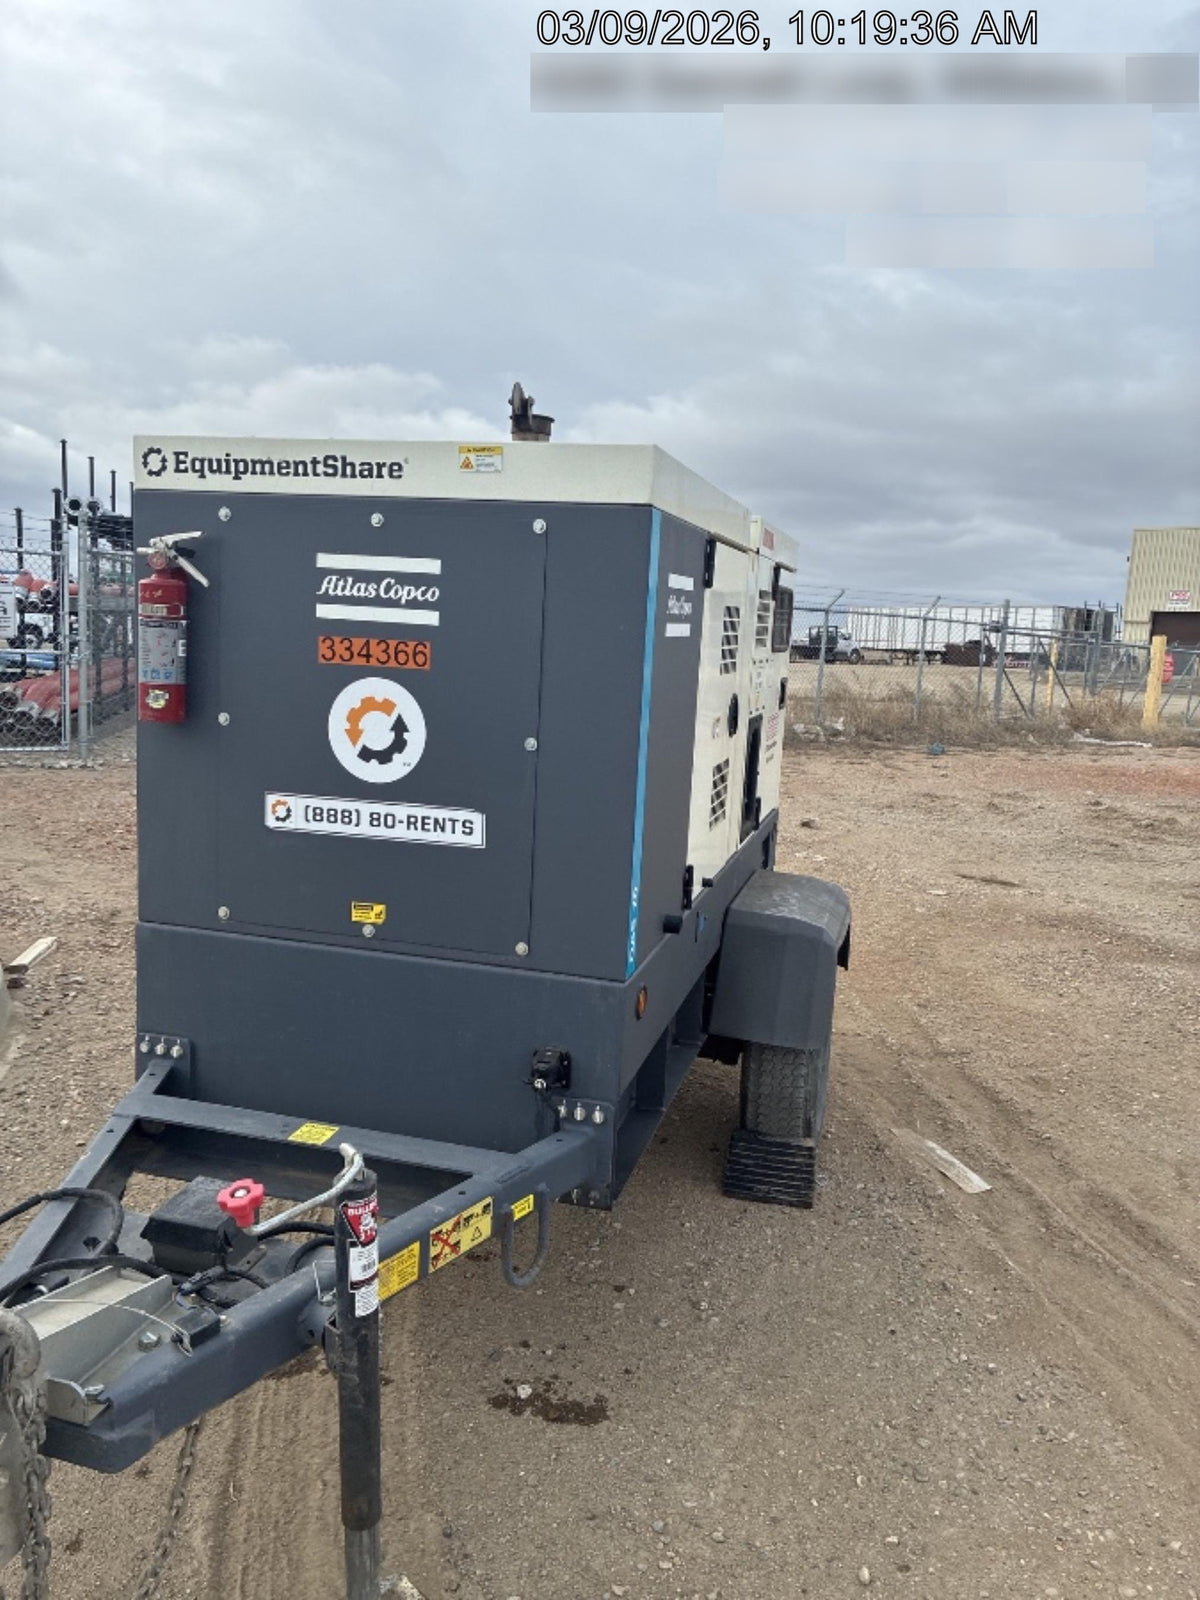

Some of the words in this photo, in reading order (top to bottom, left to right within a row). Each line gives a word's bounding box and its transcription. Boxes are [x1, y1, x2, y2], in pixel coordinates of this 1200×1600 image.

[173, 451, 404, 480] EquipmentShare
[316, 575, 378, 599] Atlas
[379, 577, 440, 605] Copco
[321, 636, 428, 668] 334366
[304, 804, 361, 828] (888)
[368, 811, 475, 837] 80-RENTS
